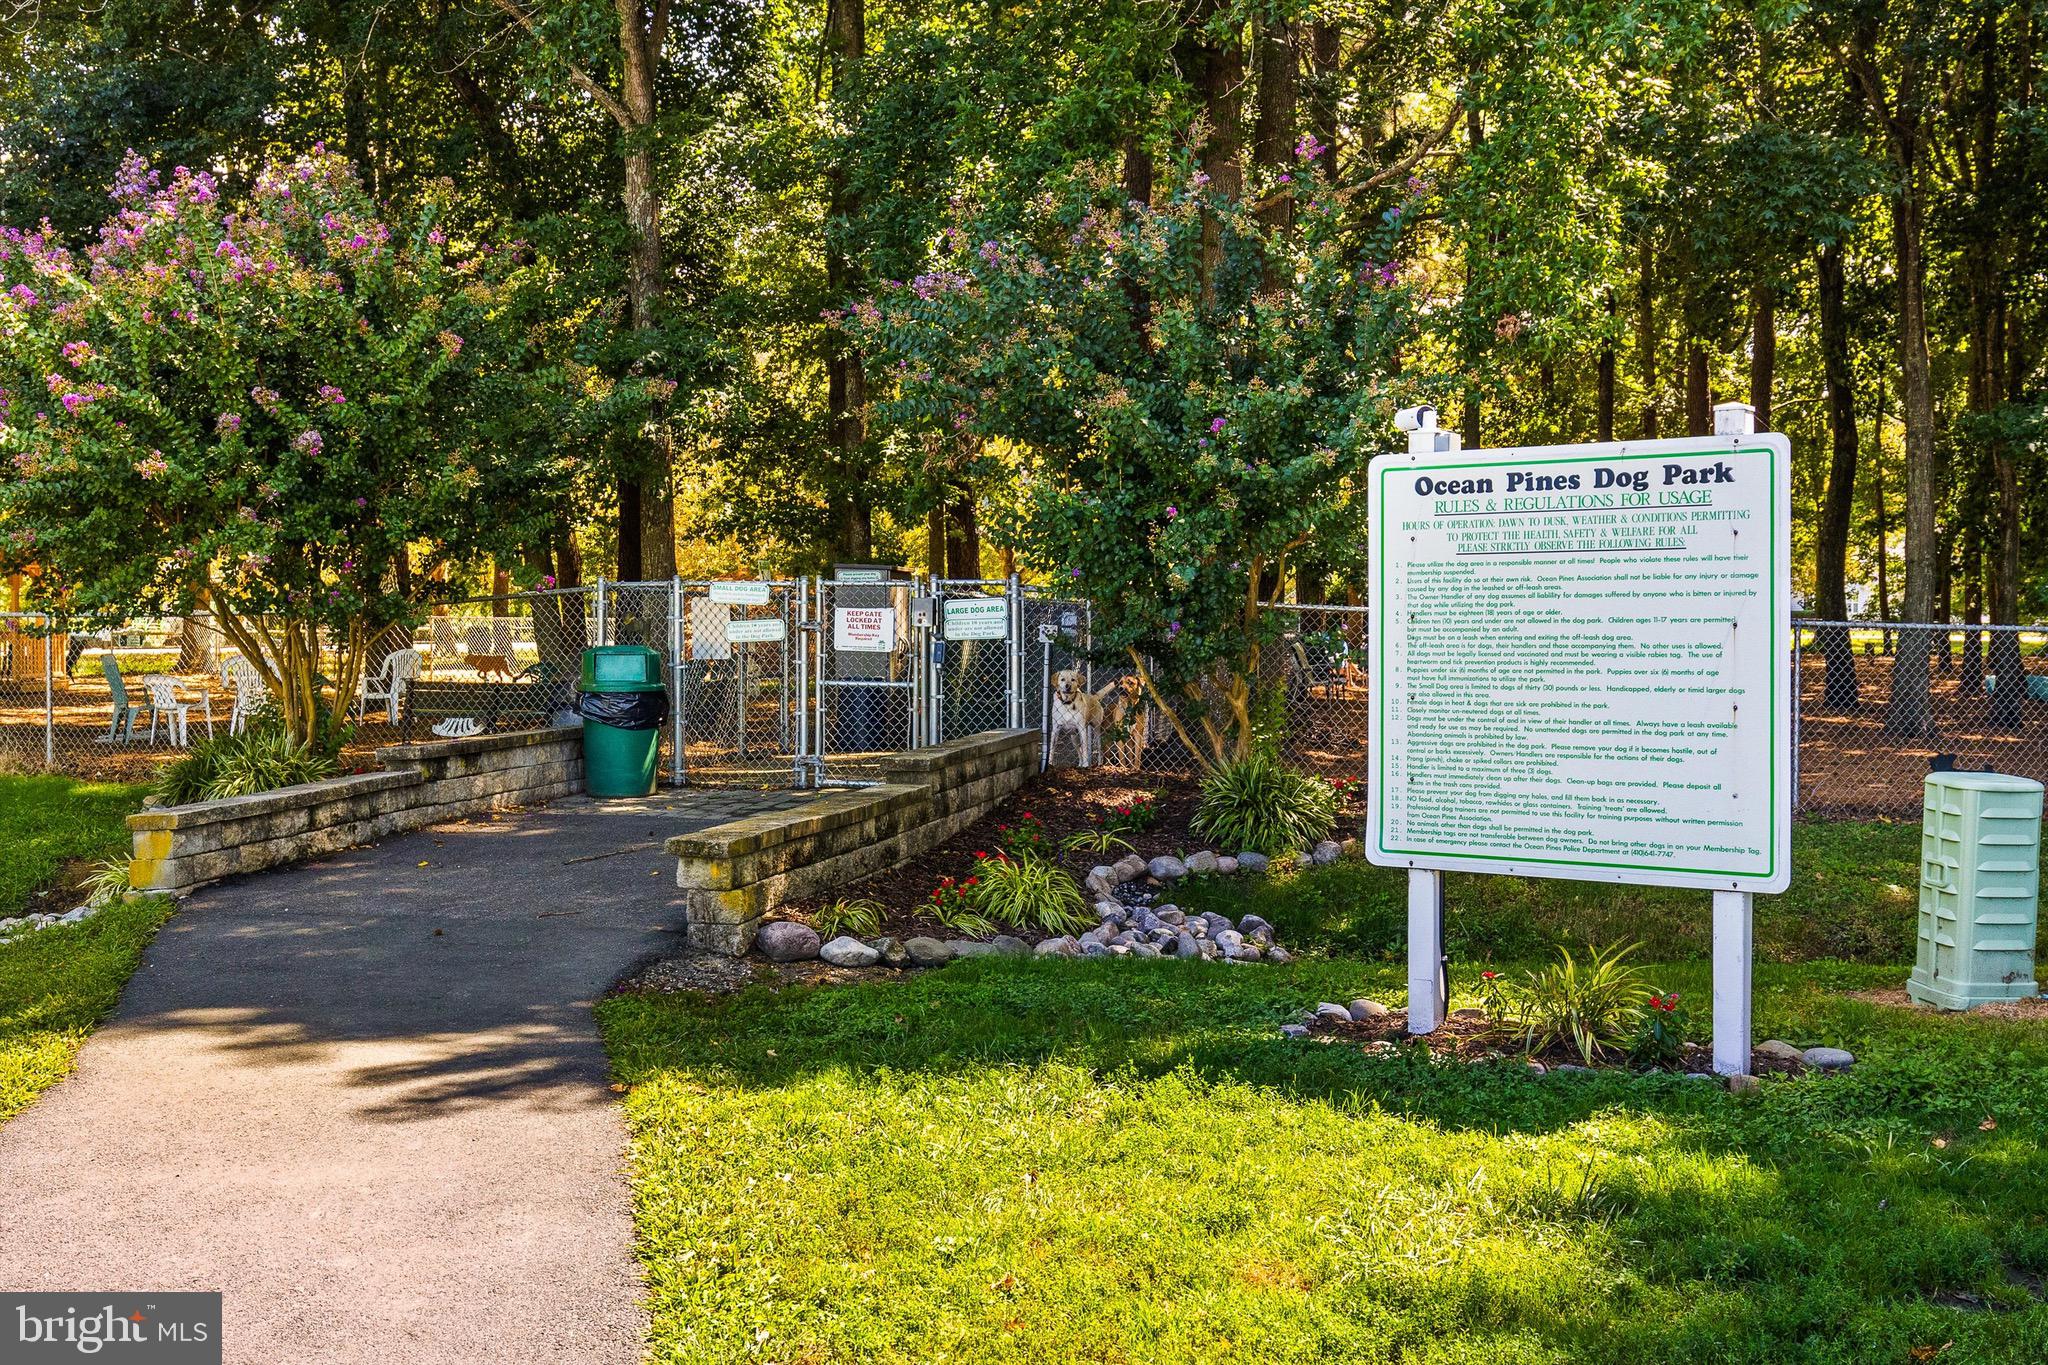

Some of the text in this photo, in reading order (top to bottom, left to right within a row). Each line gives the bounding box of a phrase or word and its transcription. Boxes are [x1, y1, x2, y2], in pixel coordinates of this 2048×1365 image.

[1415, 462, 1735, 496] Ocean Pines Dog Park
[1435, 490, 1712, 514] RULES & REGULATIONS FOR USAGE
[1402, 522, 1430, 531] HOURS
[1434, 521, 1444, 529] OF
[1499, 518, 1525, 527] DAWN
[1528, 518, 1540, 527] TO
[1572, 515, 1617, 525] WEATHER
[1621, 515, 1628, 523] &
[1632, 512, 1688, 523] CONDITIONS
[1691, 510, 1751, 521] PERMITTING
[1447, 532, 1458, 542] TO
[1462, 532, 1499, 541] PROTECT
[1502, 531, 1521, 540] THE
[1564, 528, 1596, 539] SAFETY
[1600, 528, 1607, 536] &
[1612, 526, 1655, 537] WELFARE
[1658, 526, 1676, 536] FOR
[1681, 525, 1698, 535] ALL
[1458, 543, 1488, 552] PLEASE
[1491, 542, 1530, 551] STRICTLY
[1534, 541, 1574, 550] OBSERVE
[1577, 540, 1596, 549] THE
[1600, 538, 1651, 549] FOLLOWING
[1468, 839, 1488, 847] please
[1582, 846, 1620, 855] Department
